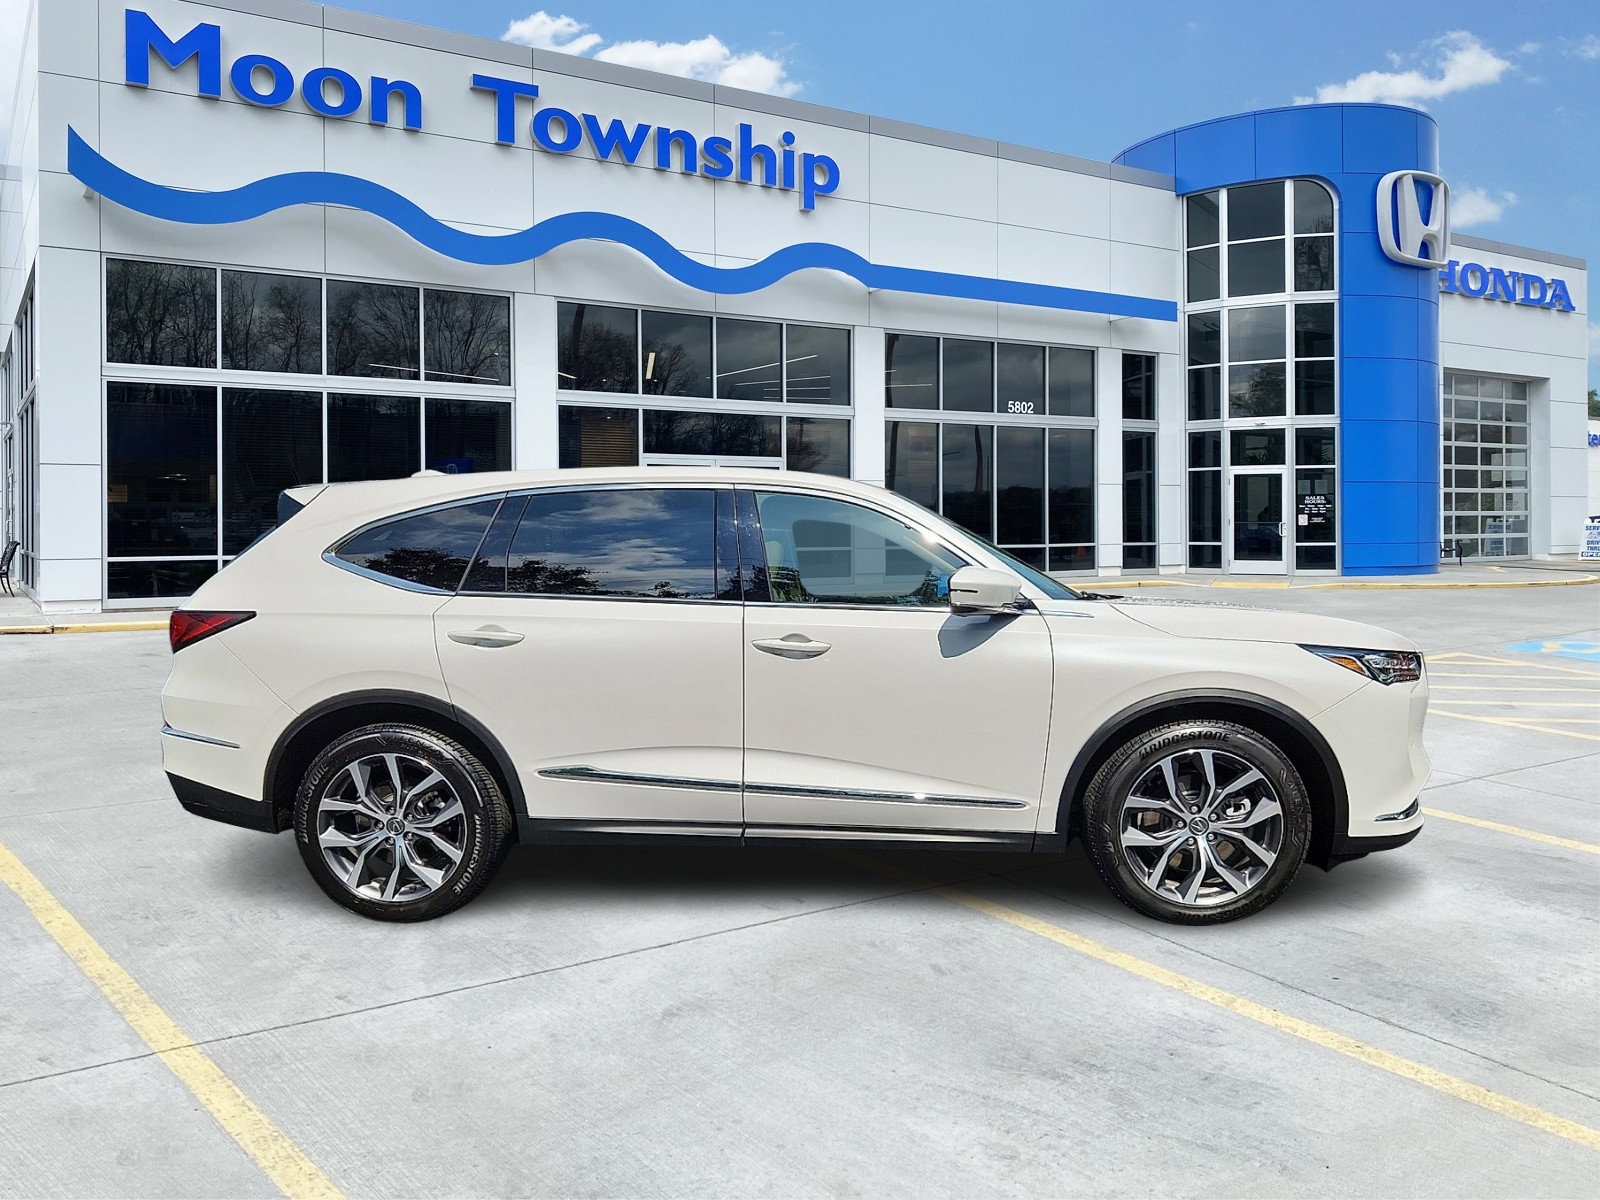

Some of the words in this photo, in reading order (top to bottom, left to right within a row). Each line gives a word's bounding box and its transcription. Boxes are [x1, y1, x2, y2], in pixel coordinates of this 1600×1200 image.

[125, 9, 423, 132] Moon
[470, 74, 840, 212] Township
[1438, 260, 1576, 311] HONDA
[1007, 400, 1034, 414] 5802
[452, 813, 482, 895] BRIDGESTONE
